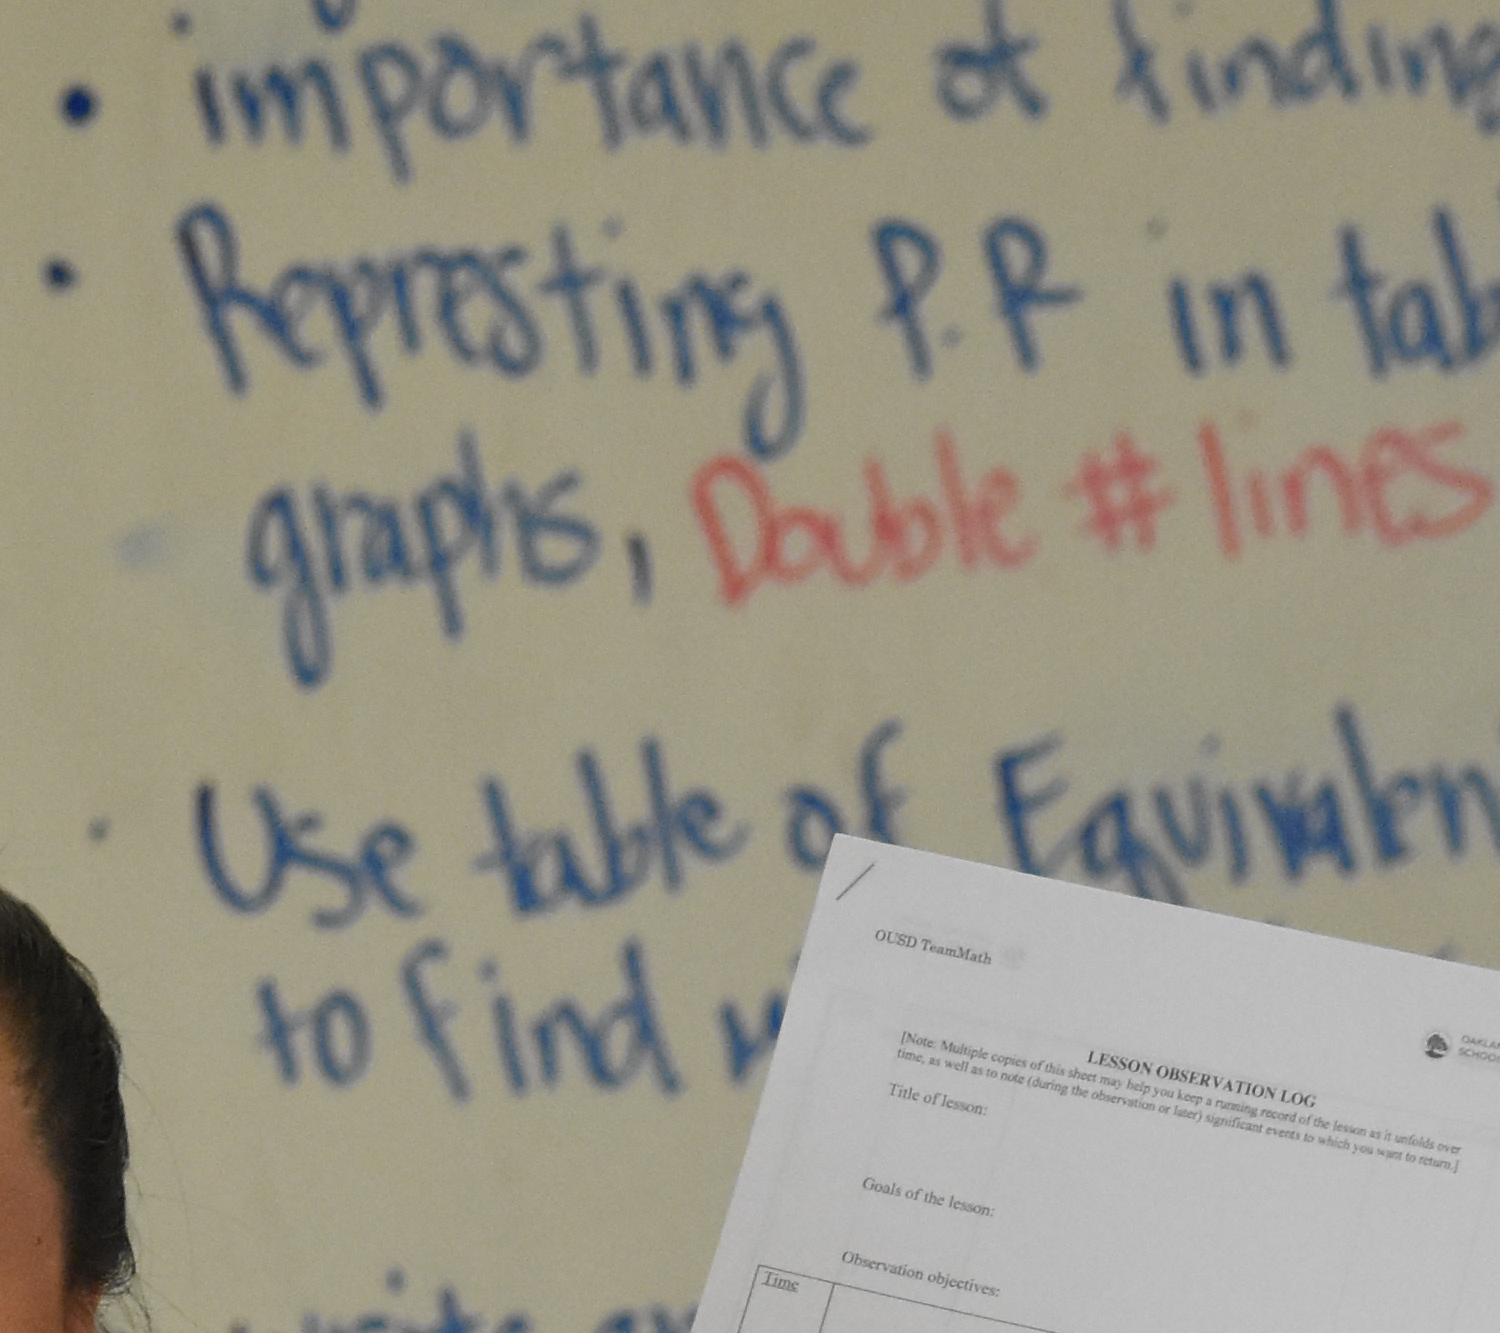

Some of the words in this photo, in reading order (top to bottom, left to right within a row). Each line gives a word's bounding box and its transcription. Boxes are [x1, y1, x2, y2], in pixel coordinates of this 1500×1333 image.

[173, 10, 875, 185] importance
[1145, 215, 1293, 376] in
[688, 431, 1038, 606] Double
[1198, 413, 1495, 562] lines
[192, 783, 418, 930] Use
[473, 737, 749, 922] table
[874, 929, 918, 949] OUSD
[921, 938, 992, 965] TeamMath
[257, 976, 371, 1088] to
[400, 935, 687, 1102] find
[889, 1082, 921, 1102] Title
[923, 1091, 941, 1106] of
[941, 1094, 988, 1116] lesson:
[900, 1030, 937, 1049] [Note:
[940, 1040, 989, 1060] Multiple
[990, 1053, 1027, 1068] copies
[1045, 1063, 1065, 1076] this
[1068, 1067, 1097, 1082] sheet
[1099, 1075, 1122, 1090] may
[1126, 1079, 1151, 1096] help
[1151, 1086, 1174, 1099] you
[1177, 1089, 1203, 1106] keep
[1215, 1098, 1258, 1118] running
[1260, 1108, 1297, 1123] record
[1313, 1117, 1330, 1130] the
[1333, 1120, 1367, 1136] lesson
[1394, 1134, 1435, 1149] unfolds
[1437, 1143, 1461, 1155] over
[1087, 1050, 1153, 1075] LESSON
[1155, 1065, 1278, 1100] OBSERVATION
[1280, 1089, 1317, 1109] LOG
[862, 1176, 902, 1198] Goals
[905, 1188, 924, 1202] of
[924, 1190, 946, 1208] the
[948, 1194, 996, 1218] lesson:
[761, 1270, 800, 1293] Time
[841, 1250, 924, 1281] Observation
[927, 1269, 1001, 1298] objectives:
